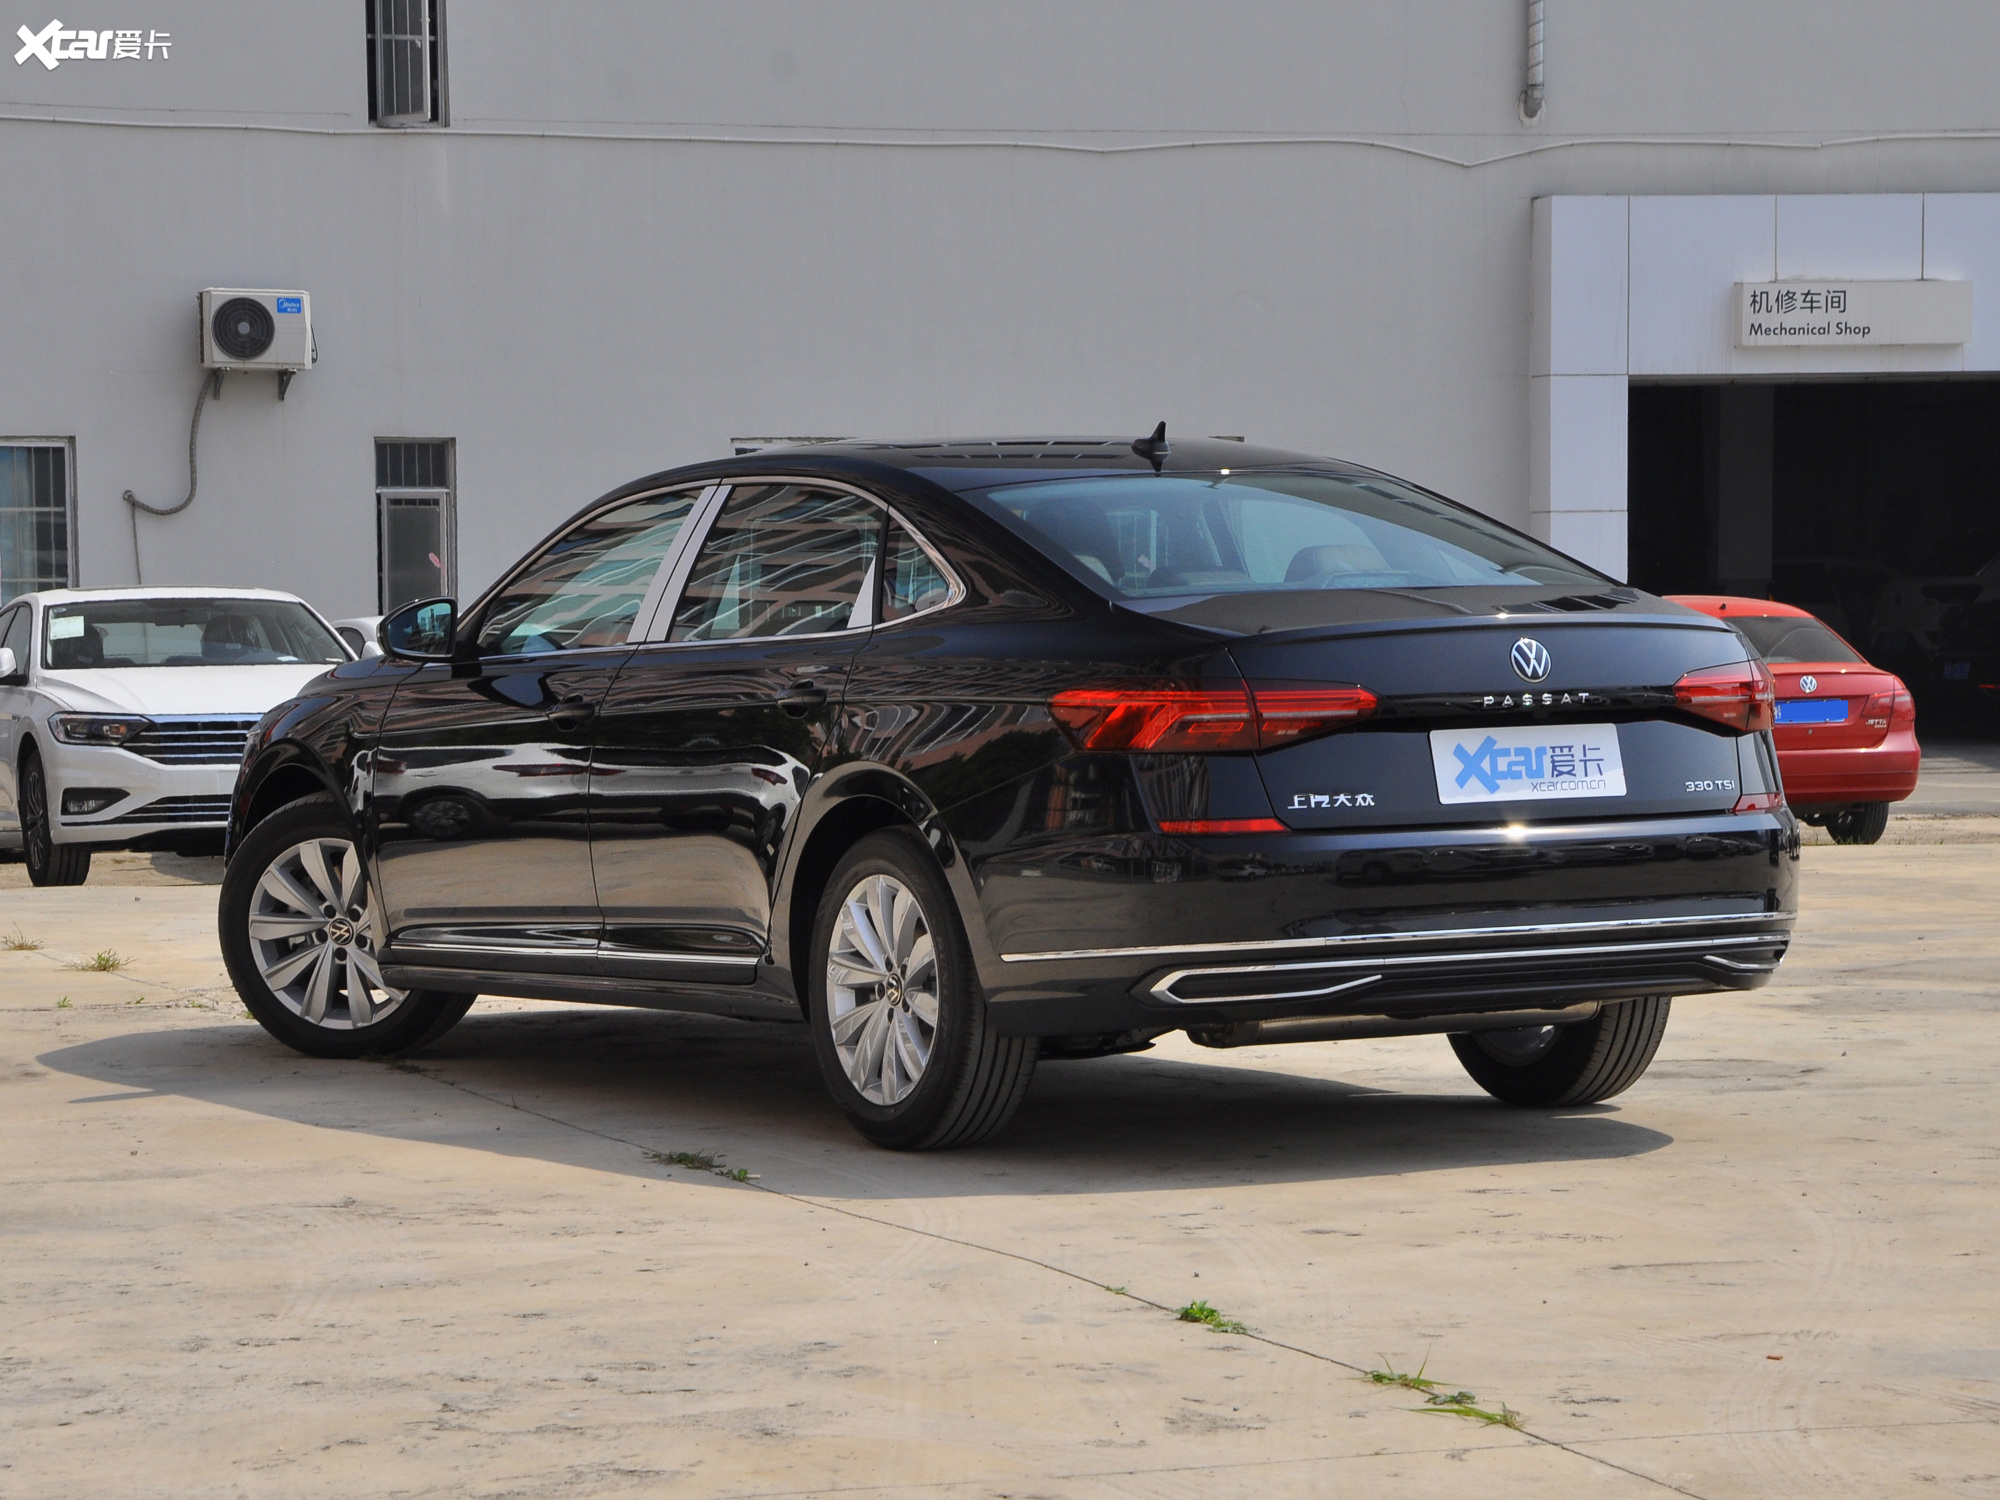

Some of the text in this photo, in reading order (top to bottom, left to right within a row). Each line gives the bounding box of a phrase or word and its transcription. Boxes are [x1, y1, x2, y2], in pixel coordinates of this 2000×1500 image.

[1750, 289, 1847, 314] 机修车间
[1749, 321, 1871, 338] Mechanical Shop
[1483, 692, 1590, 708] PASSAT
[1531, 779, 1606, 792] xcar.com.cn
[1684, 779, 1735, 792] 330 TSI
